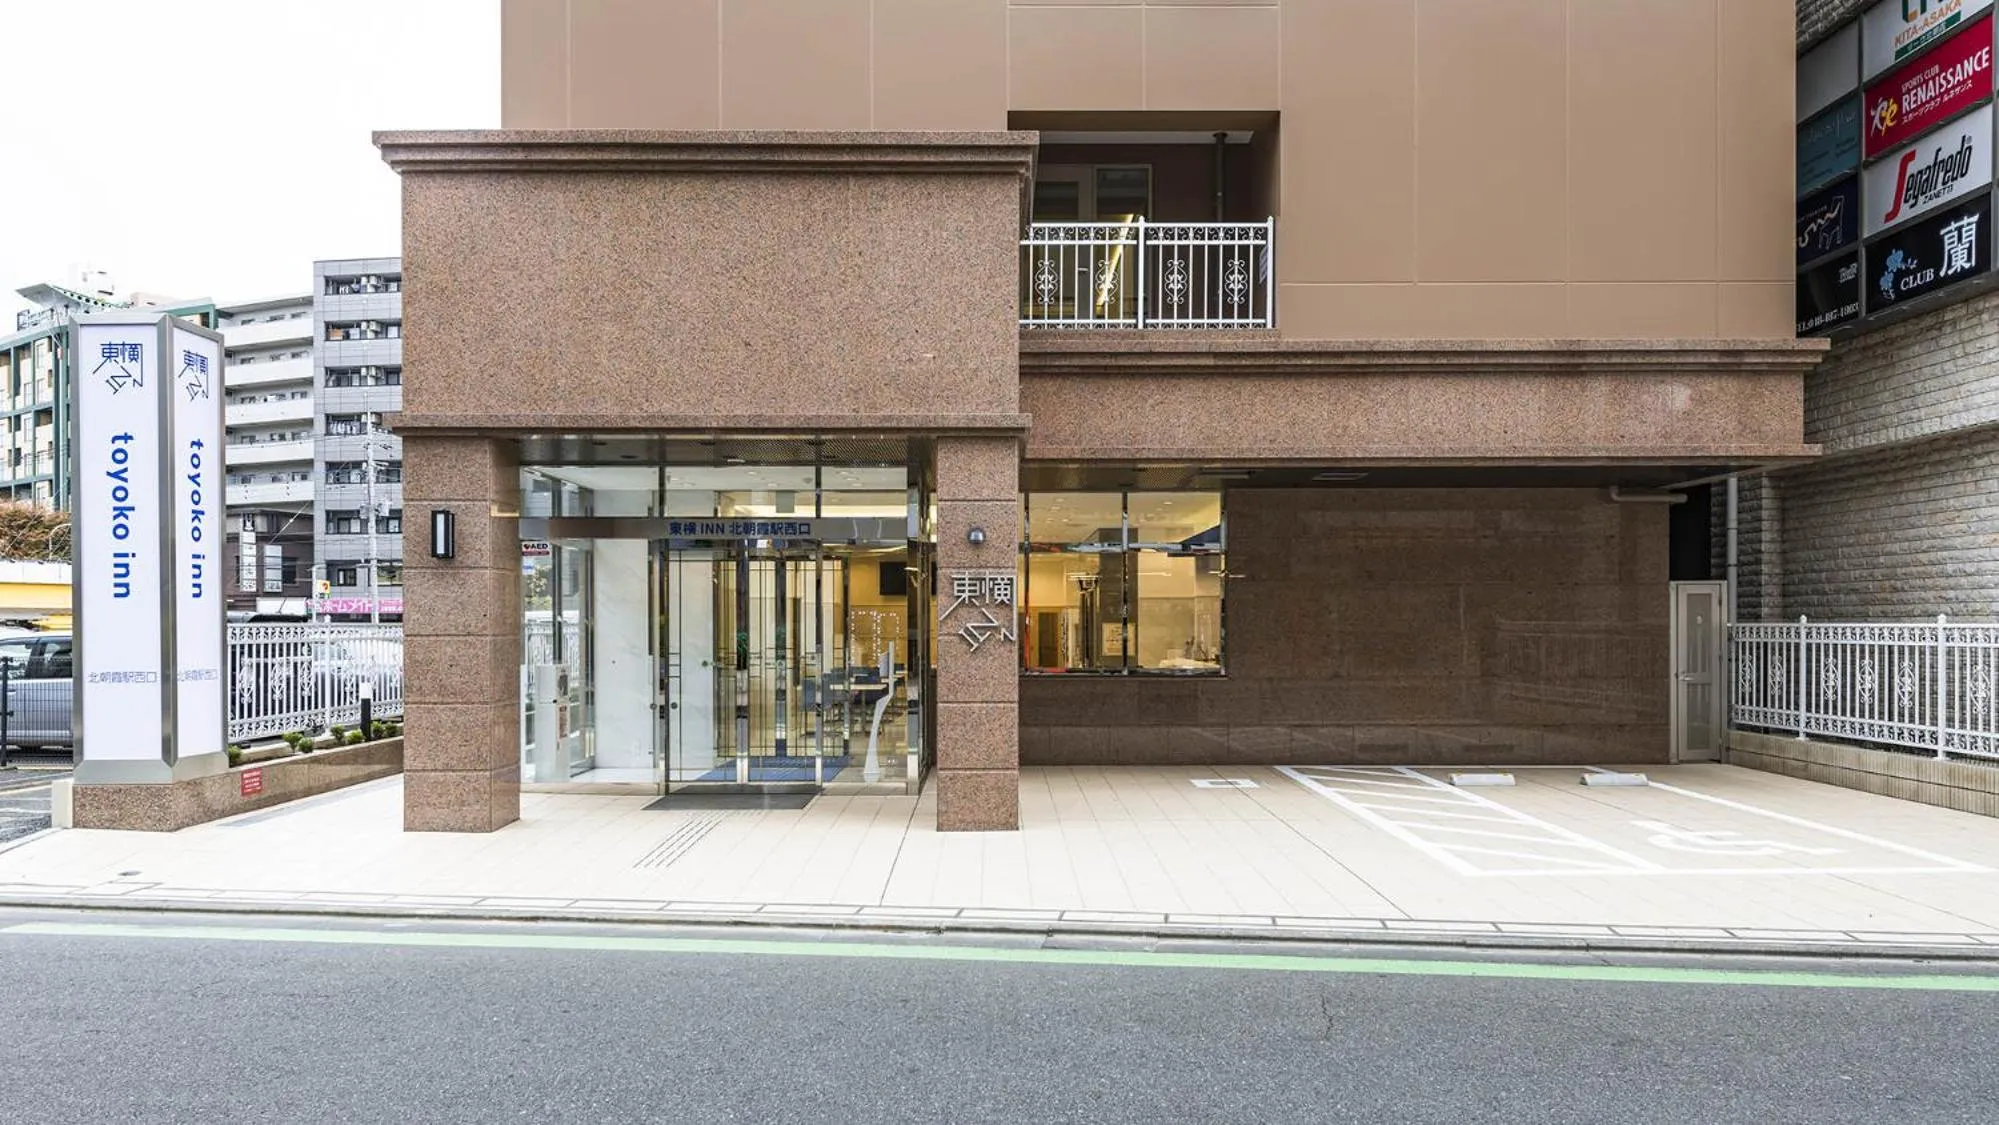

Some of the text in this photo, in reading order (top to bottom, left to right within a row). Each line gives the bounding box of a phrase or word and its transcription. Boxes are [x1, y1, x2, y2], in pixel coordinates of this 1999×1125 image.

[1902, 64, 1940, 93] SPORTS CLUB
[1902, 45, 1990, 114] RENAISSANCE
[1884, 135, 1973, 224] Segafredo
[1922, 183, 1954, 205] ZANETTI
[1900, 268, 1935, 290] CLUB
[1940, 213, 1980, 278] 蘭
[106, 432, 136, 598] toyoko inn
[188, 438, 205, 598] toyoko inn
[670, 522, 811, 535] 東横 INN 北朝霞駅西口
